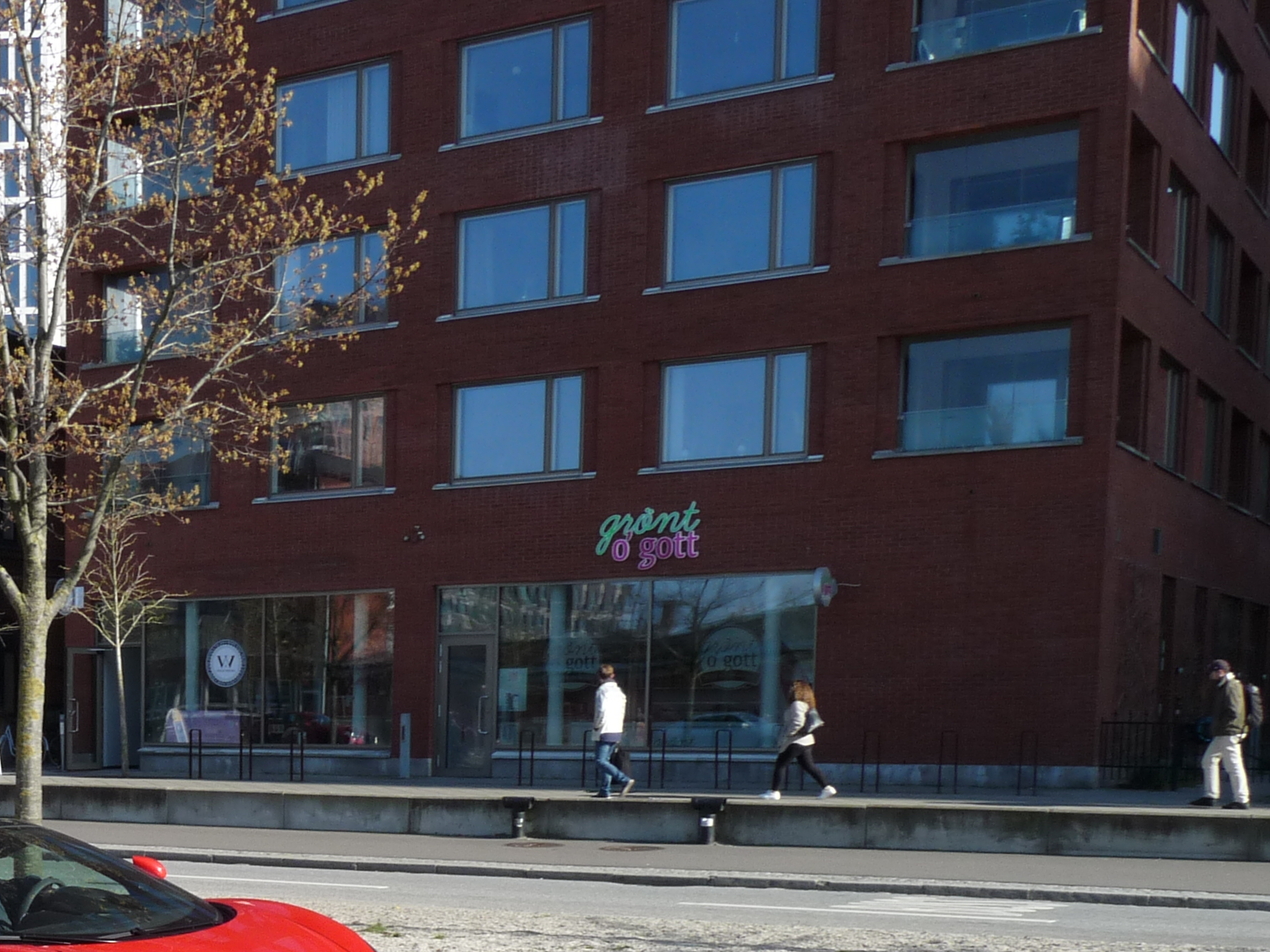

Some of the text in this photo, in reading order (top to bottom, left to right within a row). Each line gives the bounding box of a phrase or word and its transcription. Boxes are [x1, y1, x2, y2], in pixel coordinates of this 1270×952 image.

[637, 531, 700, 571] gott
[565, 655, 598, 670] gott
[723, 652, 758, 671] gott
